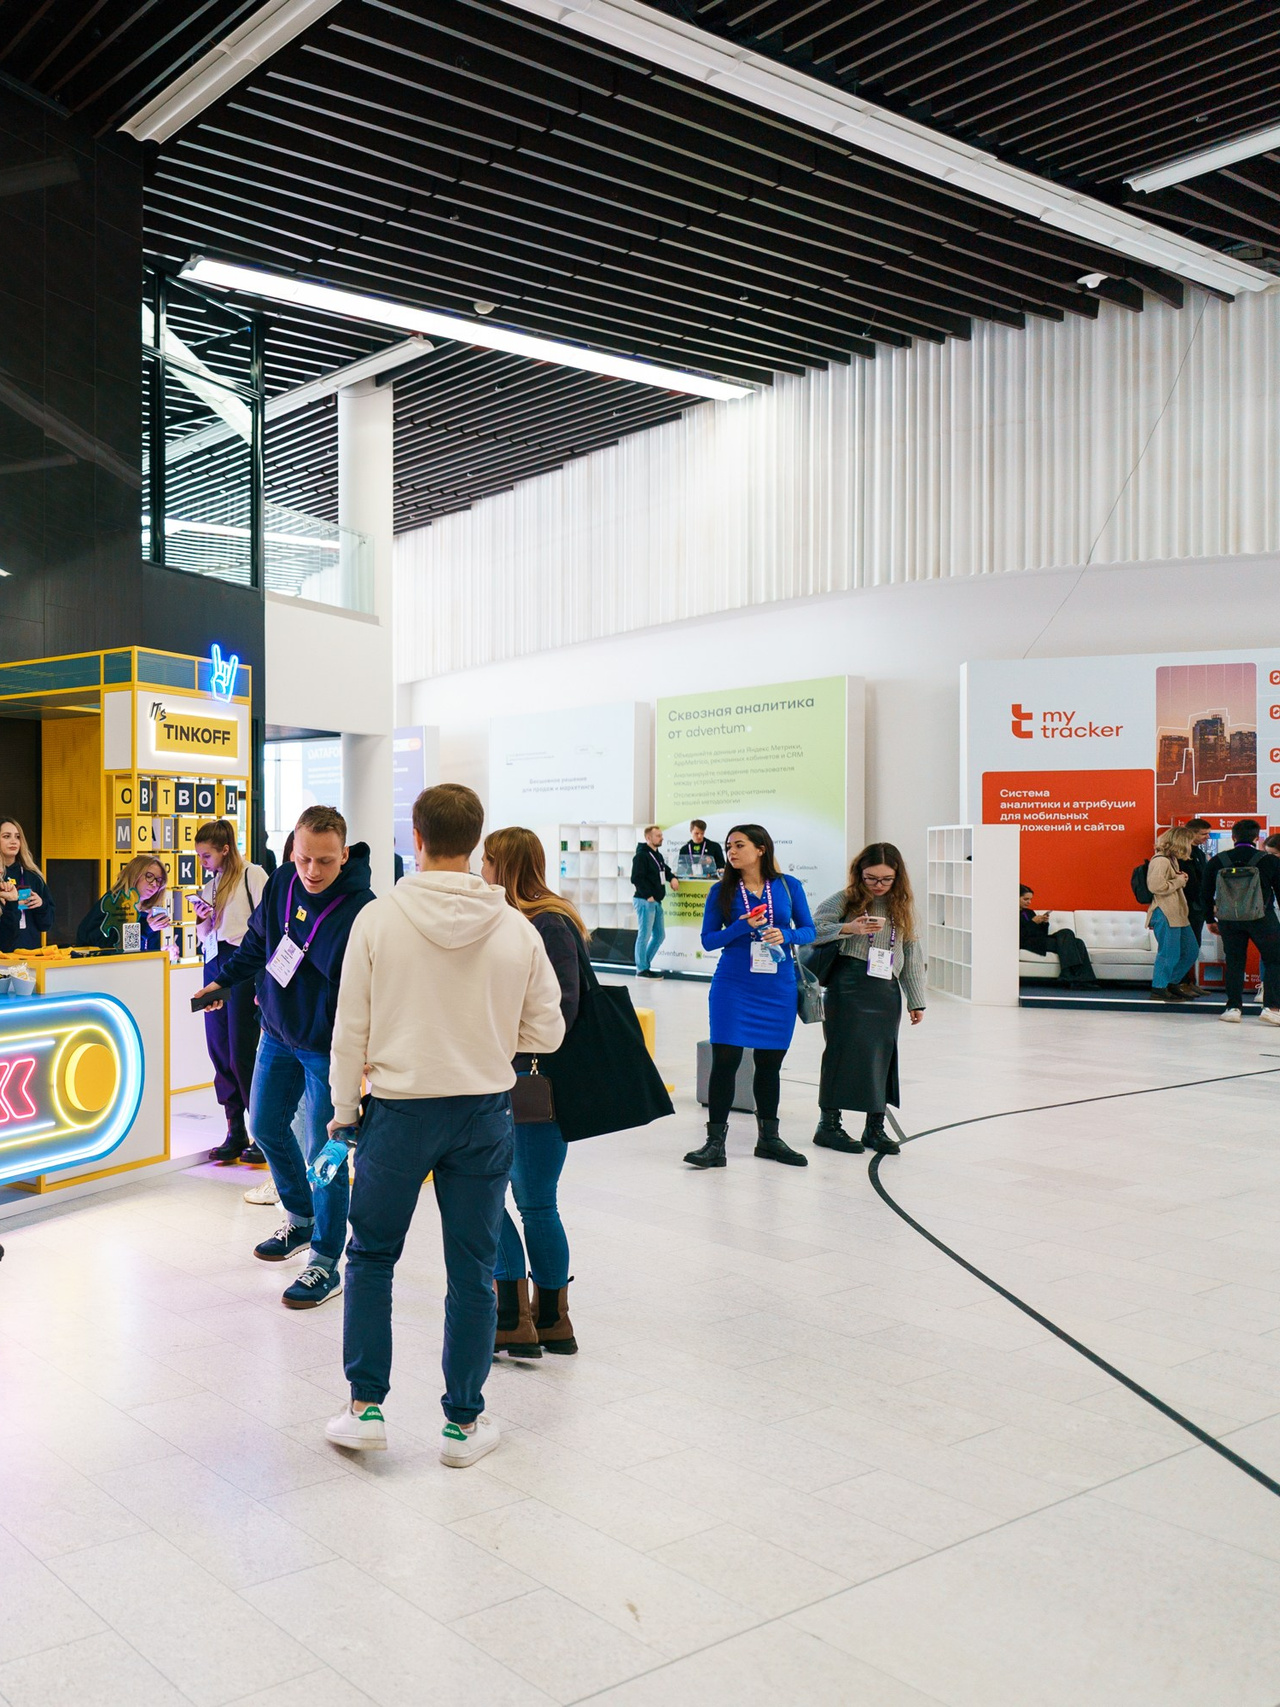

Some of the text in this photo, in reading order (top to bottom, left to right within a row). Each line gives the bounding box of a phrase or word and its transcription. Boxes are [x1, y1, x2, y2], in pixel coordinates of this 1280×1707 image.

[668, 697, 815, 722] Сквозная аналитика
[1042, 711, 1076, 726] my
[163, 723, 231, 745] TINKOFF
[668, 723, 746, 740] от adventum
[1040, 721, 1124, 738] tracker
[786, 750, 804, 759] CRM
[1000, 789, 1050, 798] Система
[1000, 801, 1061, 809] аналитики
[1072, 799, 1136, 810] атрибуции
[1000, 811, 1089, 821] для мобильных
[1020, 822, 1072, 832] ложений
[1083, 822, 1125, 832] сайтов
